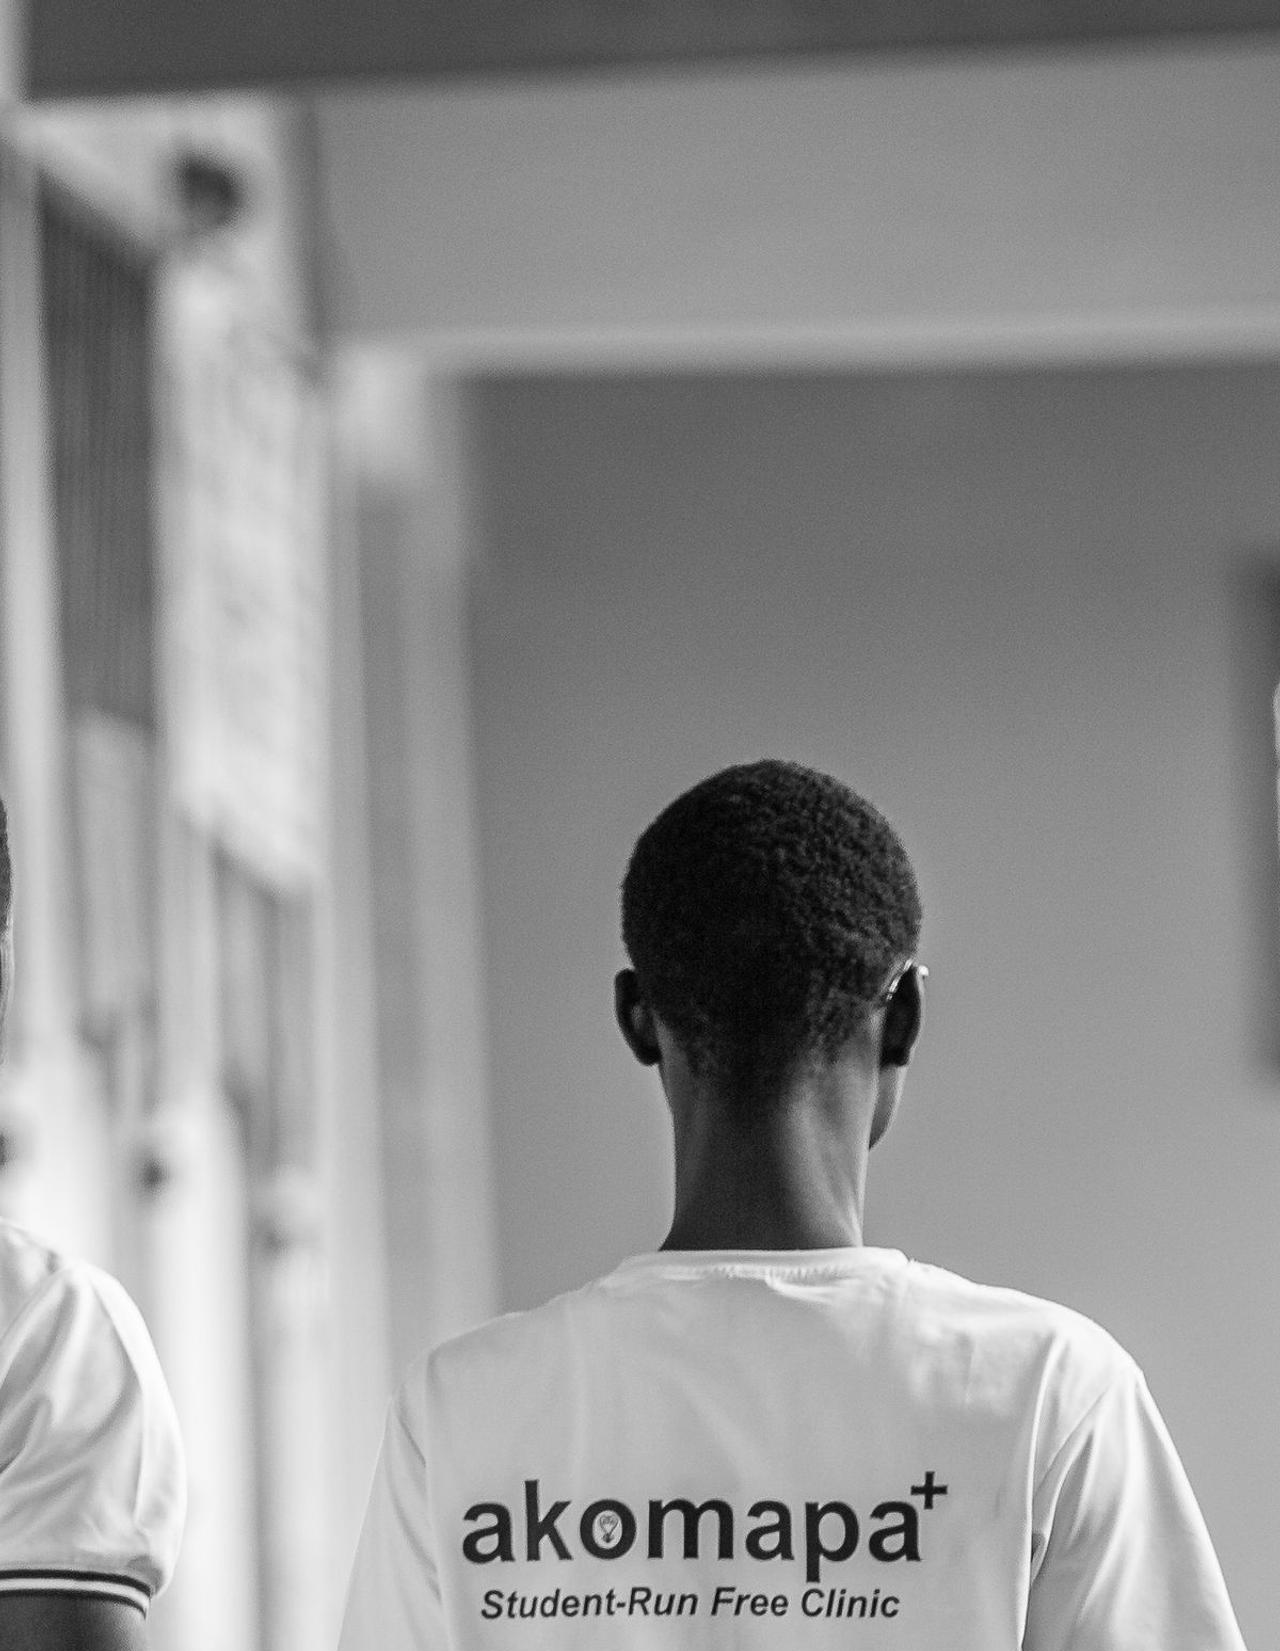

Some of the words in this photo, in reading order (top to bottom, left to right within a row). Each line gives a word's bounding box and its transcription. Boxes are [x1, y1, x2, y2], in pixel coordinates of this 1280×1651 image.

[481, 1586, 699, 1620] Student-Run
[710, 1586, 789, 1618] Free
[801, 1587, 900, 1619] Clinic
